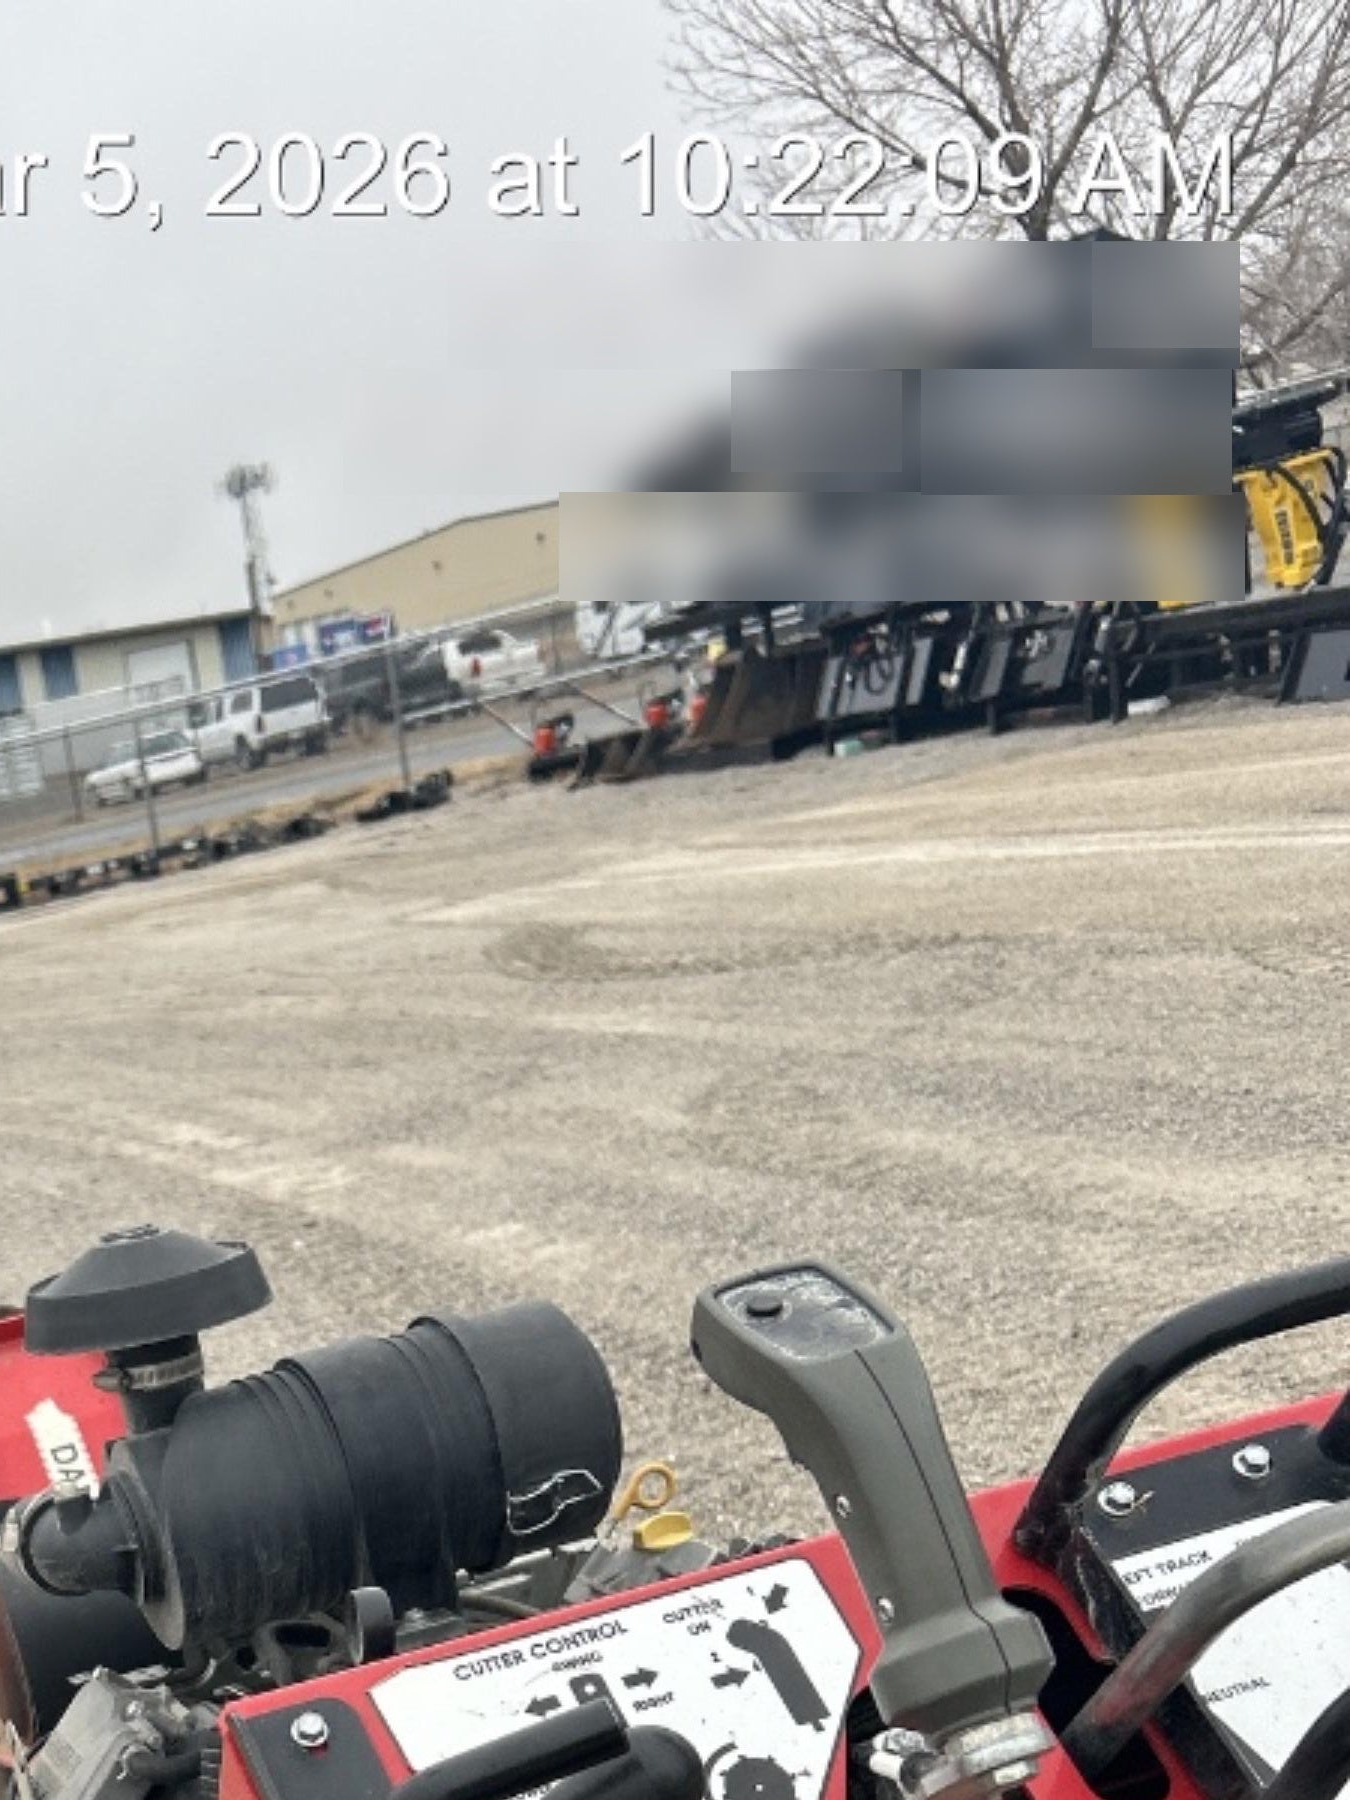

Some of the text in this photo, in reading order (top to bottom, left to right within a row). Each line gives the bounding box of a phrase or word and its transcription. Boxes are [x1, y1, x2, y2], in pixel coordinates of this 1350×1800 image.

[1122, 1550, 1213, 1584] EFT TRACK
[452, 1618, 628, 1682] CUTTER CONTROL
[632, 1690, 674, 1713] RIGHT
